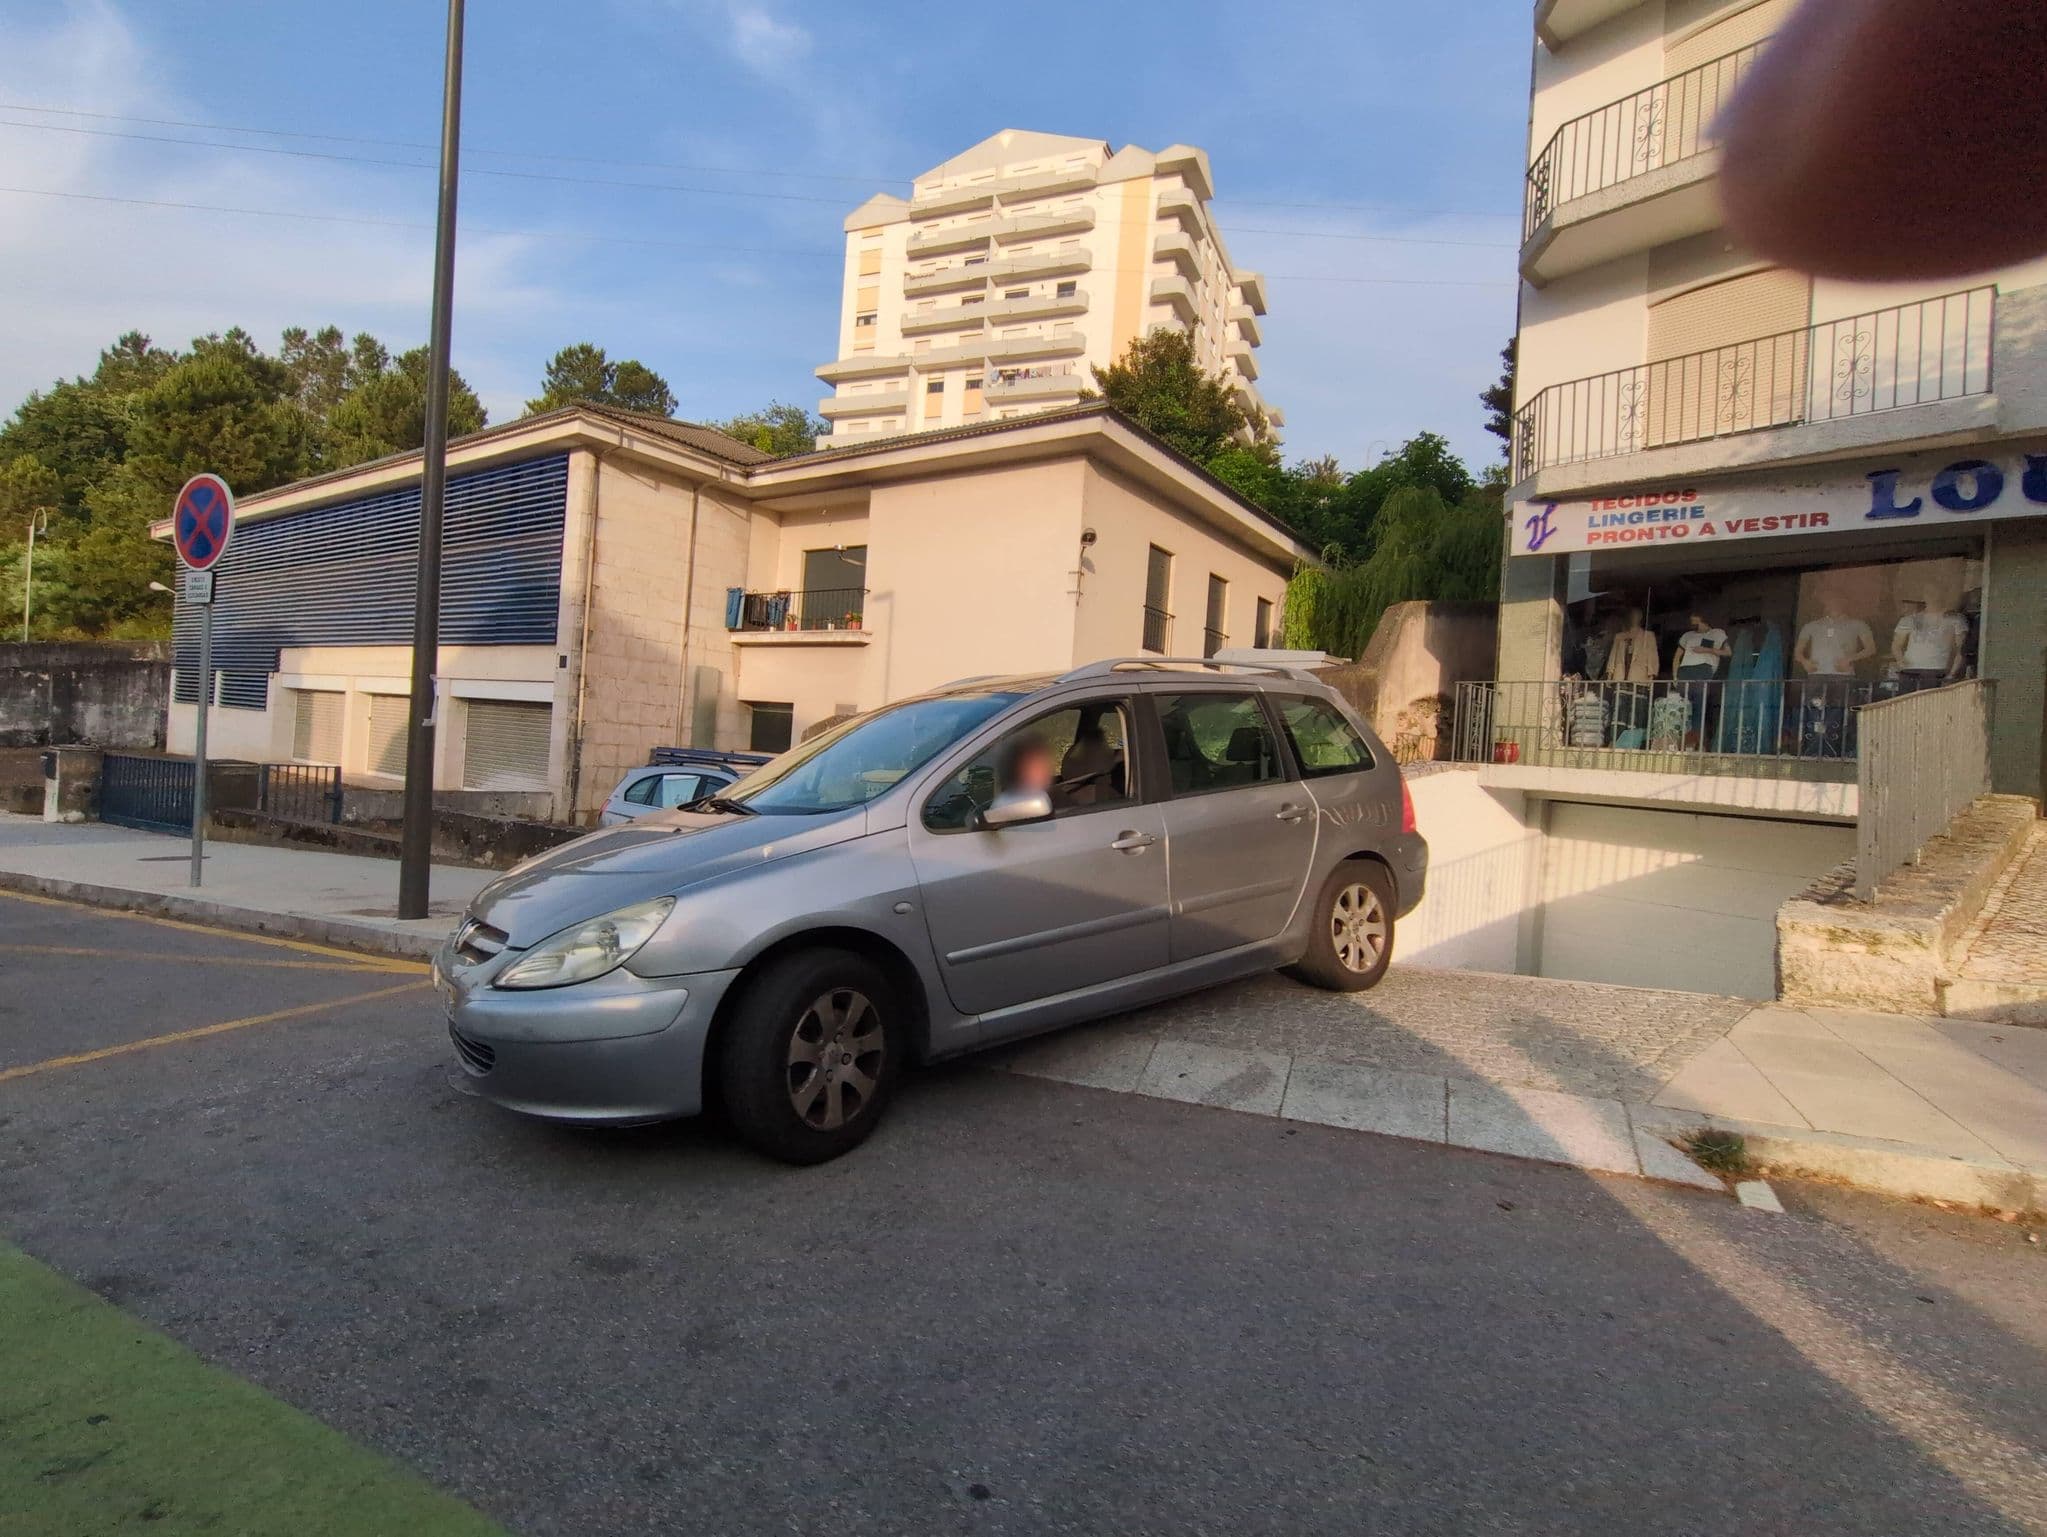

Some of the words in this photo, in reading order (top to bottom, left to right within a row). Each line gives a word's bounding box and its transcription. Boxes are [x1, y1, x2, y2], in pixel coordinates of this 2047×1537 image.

[1592, 488, 1697, 511] TECIDOS
[1587, 524, 1690, 545] PRONTO
[1698, 522, 1716, 536] A
[1725, 512, 1830, 534] VESTIR
[1588, 506, 1705, 528] LINGERIE
